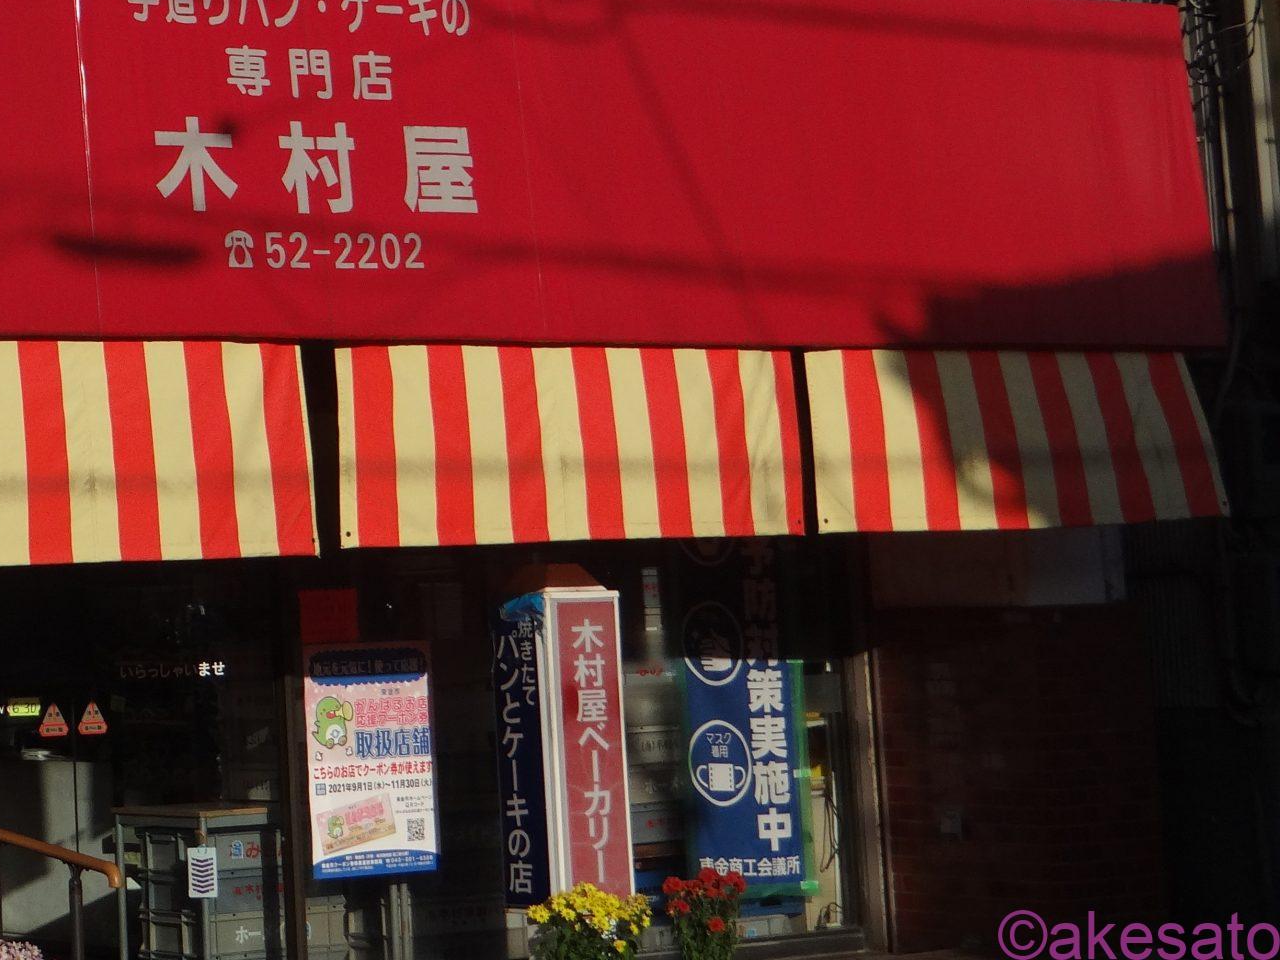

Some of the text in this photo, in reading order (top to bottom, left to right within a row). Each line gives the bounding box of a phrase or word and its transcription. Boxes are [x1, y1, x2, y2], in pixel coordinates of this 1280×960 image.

[225, 45, 393, 101] 専門店
[154, 116, 478, 214] 木村屋
[265, 231, 425, 270] 52-2202
[121, 661, 225, 679] いらっしゃいませ
[355, 727, 431, 759] 取扱店舗
[571, 618, 612, 884] 木村屋ベーカリー
[706, 732, 732, 745] マスク
[314, 762, 433, 780] こちらのお店でクーポン券が使えます
[497, 628, 533, 895] パンとケーキの店
